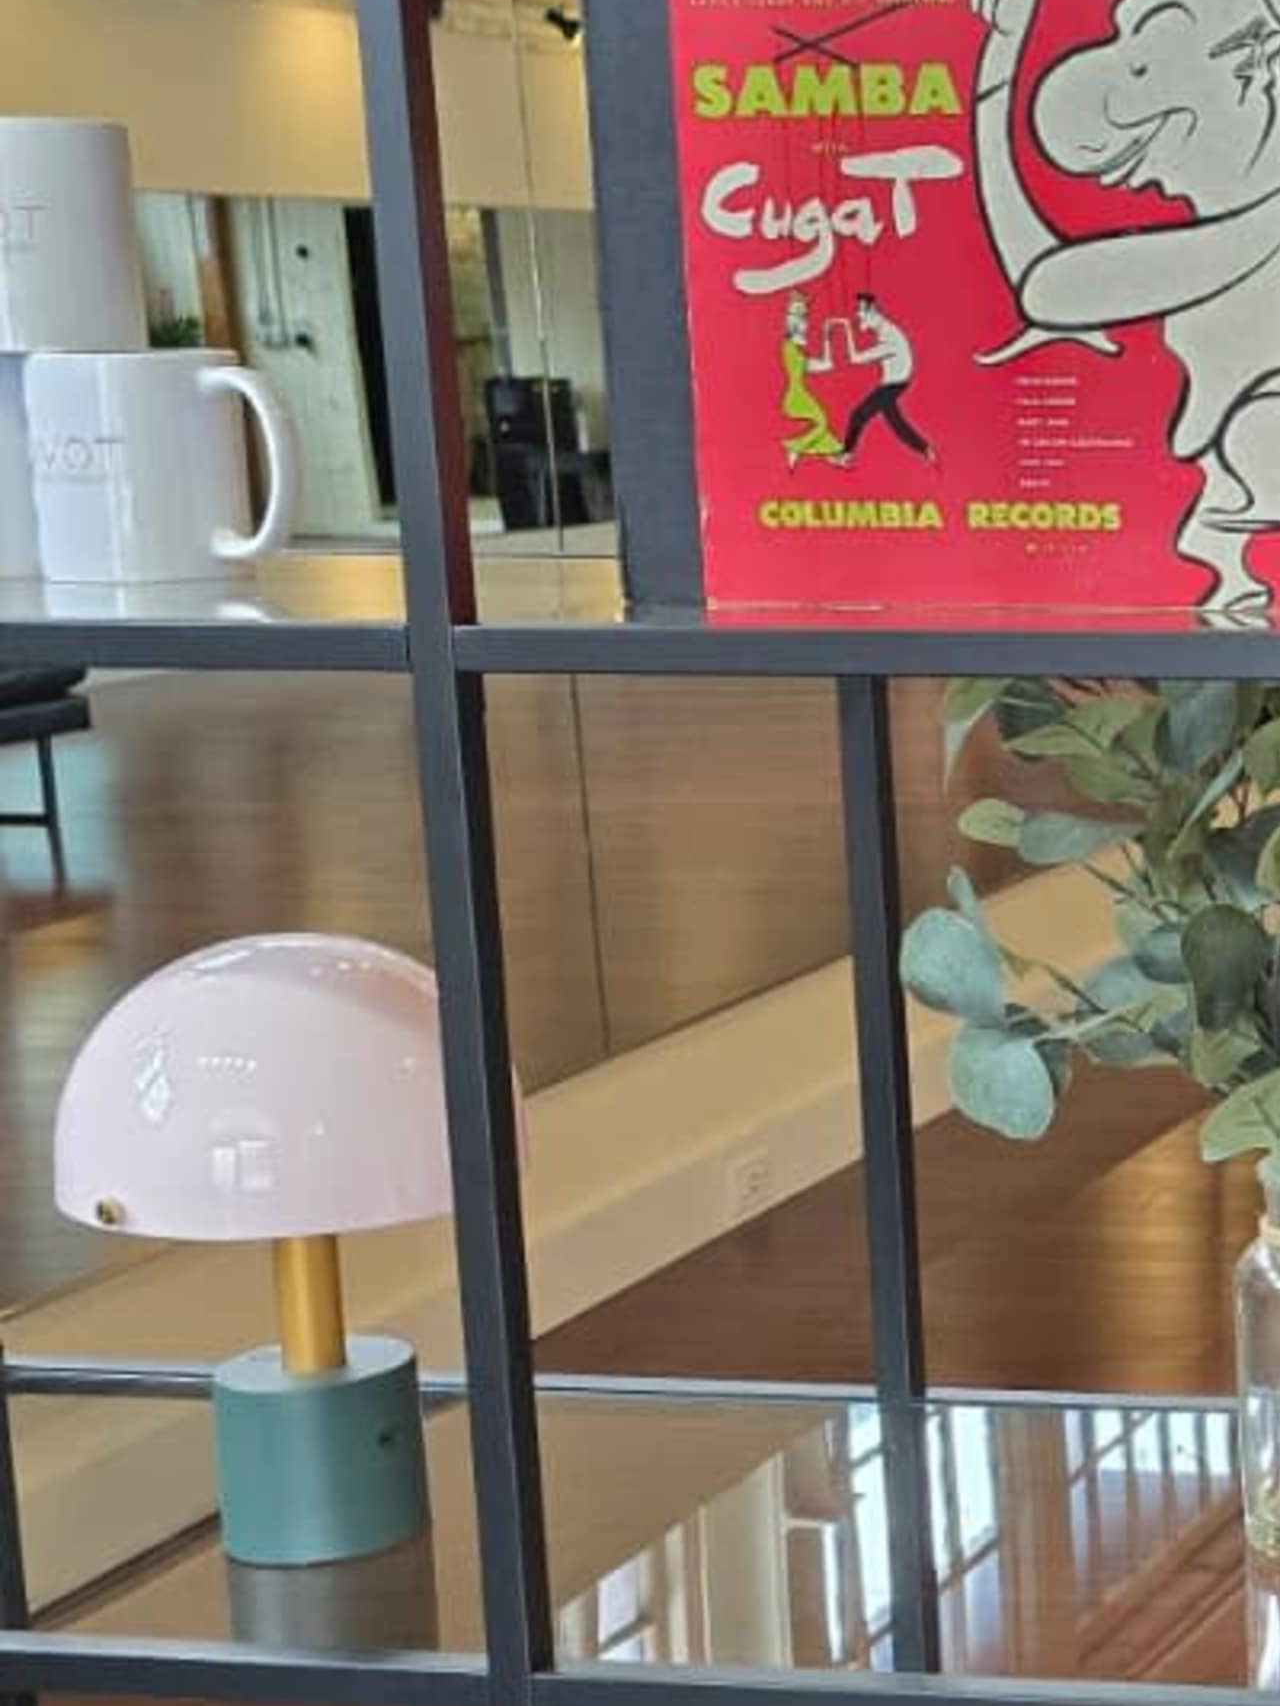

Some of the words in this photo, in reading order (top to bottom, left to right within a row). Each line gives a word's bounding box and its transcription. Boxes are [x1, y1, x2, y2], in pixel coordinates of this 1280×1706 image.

[692, 62, 963, 117] SAMBA
[760, 501, 944, 529] COLUMBIA
[967, 502, 1121, 531] RECORDS
